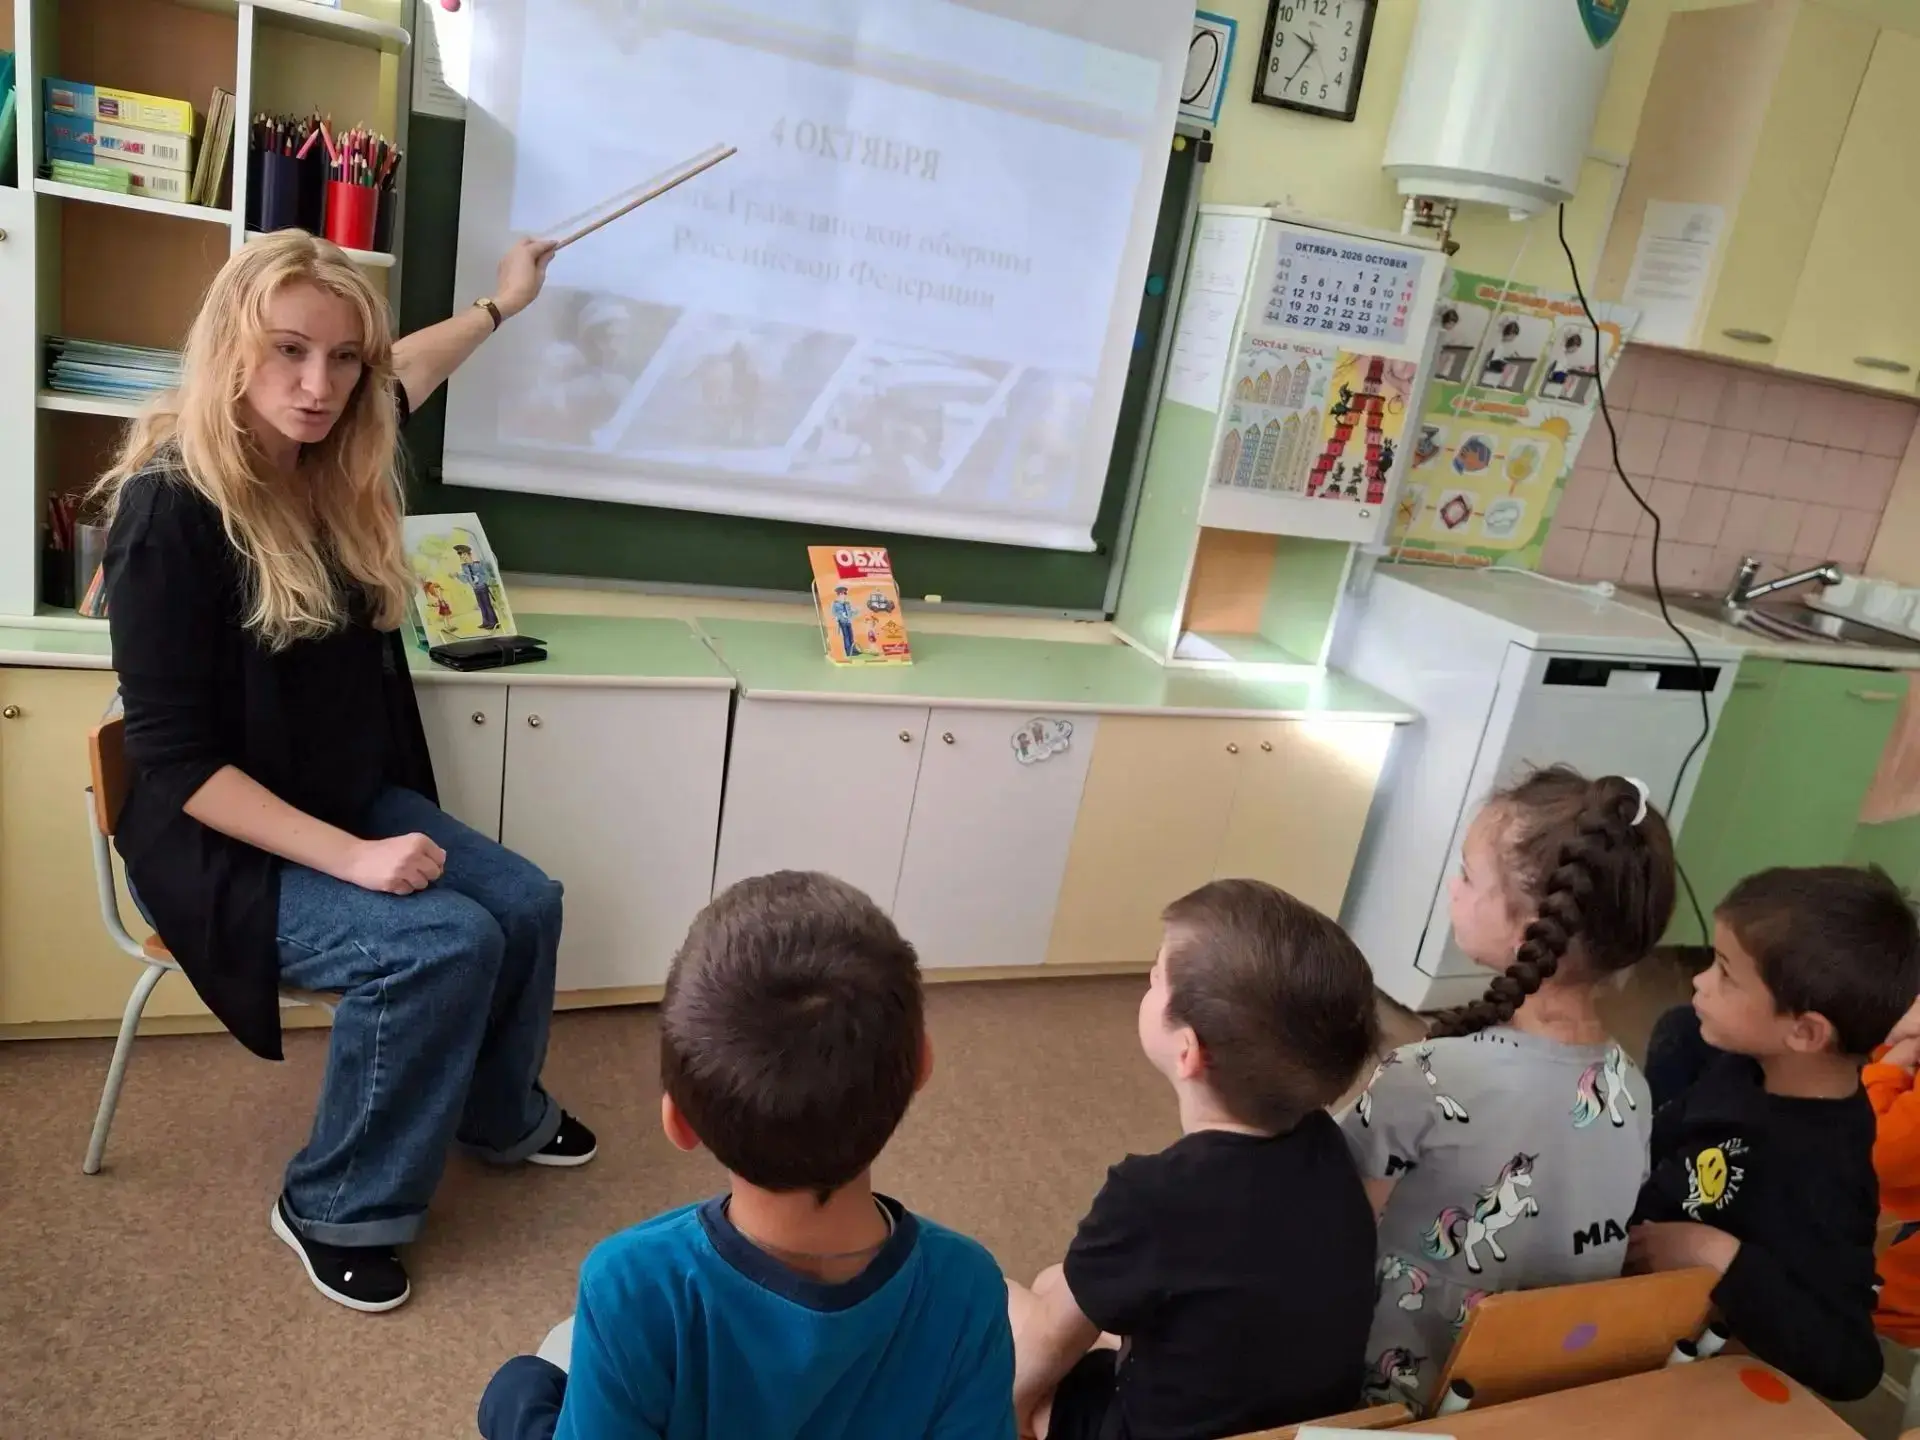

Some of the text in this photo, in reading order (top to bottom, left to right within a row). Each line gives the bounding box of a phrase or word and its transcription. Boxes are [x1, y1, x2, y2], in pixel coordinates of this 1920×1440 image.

[1279, 5, 1293, 22] 10
[1314, 0, 1328, 16] 12
[1335, 3, 1341, 19] 1
[1344, 21, 1353, 37] 2
[1275, 32, 1284, 48] 9
[1339, 46, 1348, 62] 3
[1270, 57, 1280, 73] 8
[1334, 72, 1343, 87] 4
[1300, 80, 1309, 96] 6
[1318, 84, 1328, 99] 5
[770, 116, 941, 182] 4 ОКТЯБРЯ
[1295, 242, 1338, 257] ОКТЯБРЬ
[1340, 250, 1362, 262] 2026
[1358, 272, 1364, 280] 1
[1372, 274, 1380, 283] 2
[1300, 275, 1308, 284] 5
[1318, 278, 1325, 287] 6
[1336, 281, 1342, 290] 7
[1353, 284, 1360, 292] 8
[1370, 287, 1376, 296] 9
[1383, 289, 1394, 299] 10
[1293, 288, 1304, 298] 12
[1310, 291, 1321, 301] 13
[1328, 294, 1339, 303] 14
[1345, 296, 1356, 306] 15
[1362, 300, 1373, 309] 16
[1380, 302, 1391, 312] 17
[1289, 300, 1301, 311] 19
[1306, 304, 1319, 314] 20
[1324, 306, 1336, 316] 21
[1340, 309, 1354, 319] 22
[1358, 312, 1370, 322] 23
[1376, 314, 1388, 324] 24
[1285, 314, 1298, 324] 26
[1303, 316, 1316, 327] 27
[1320, 319, 1333, 330] 28
[1338, 322, 1350, 332] 29
[1355, 324, 1368, 334] 30
[835, 549, 889, 568] ОБЖ
